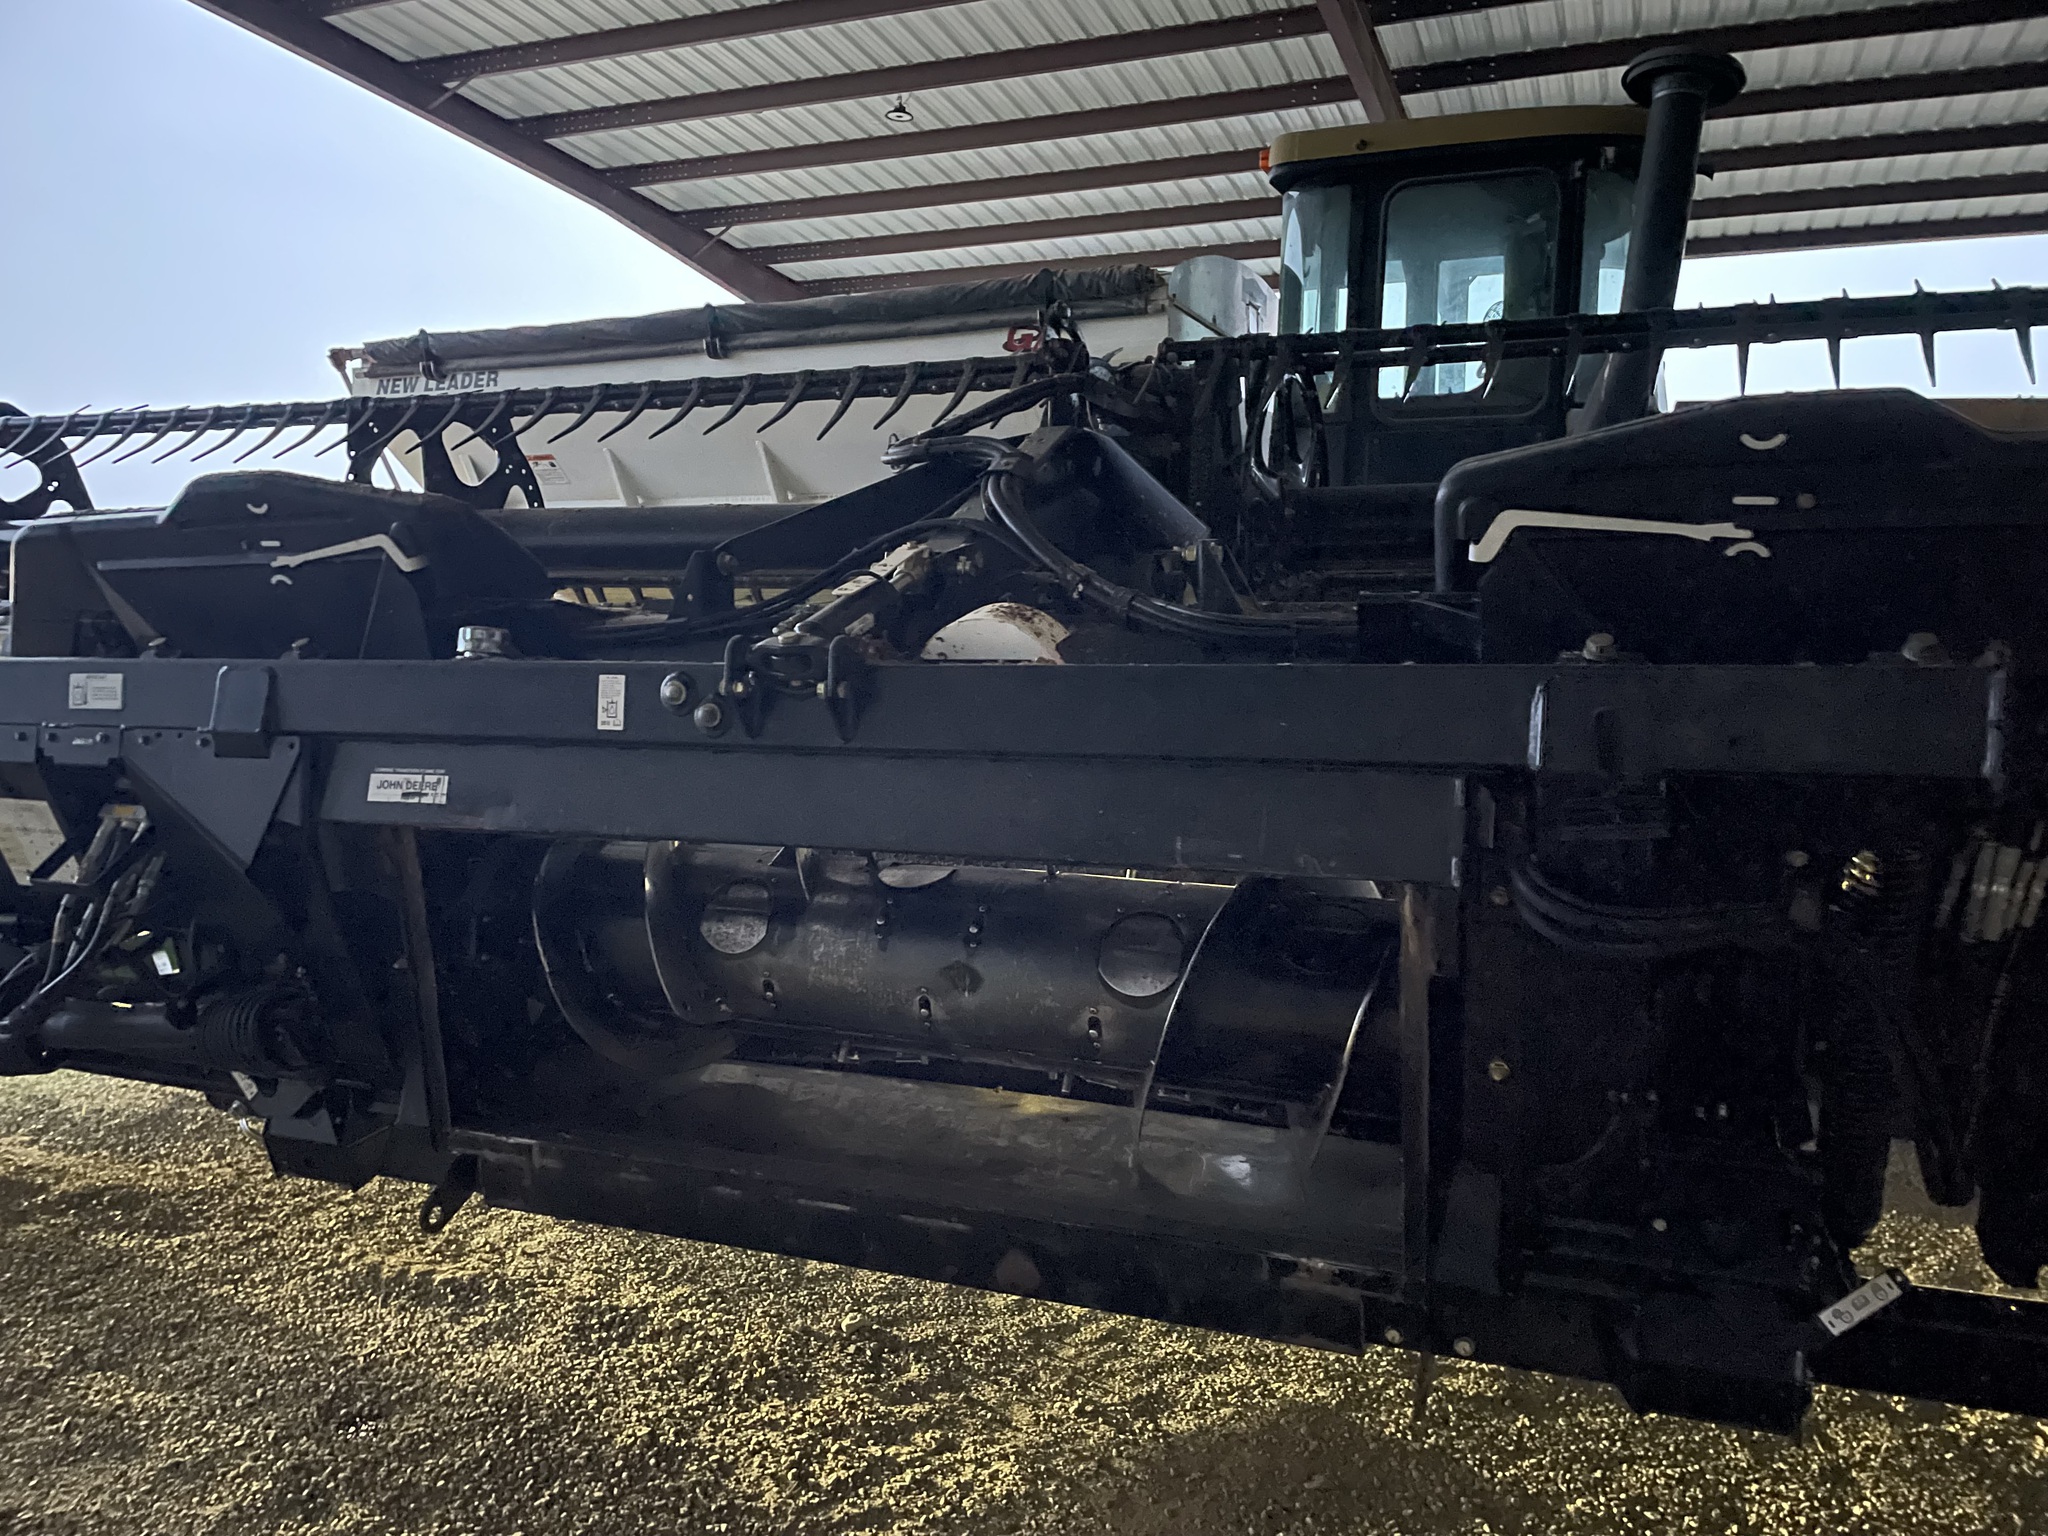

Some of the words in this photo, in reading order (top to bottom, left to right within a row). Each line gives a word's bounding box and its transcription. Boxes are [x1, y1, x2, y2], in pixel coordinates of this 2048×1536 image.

[376, 376, 419, 395] NEW
[423, 370, 499, 392] LEADER
[376, 779, 402, 790] JOHN
[405, 780, 438, 791] DEERE
